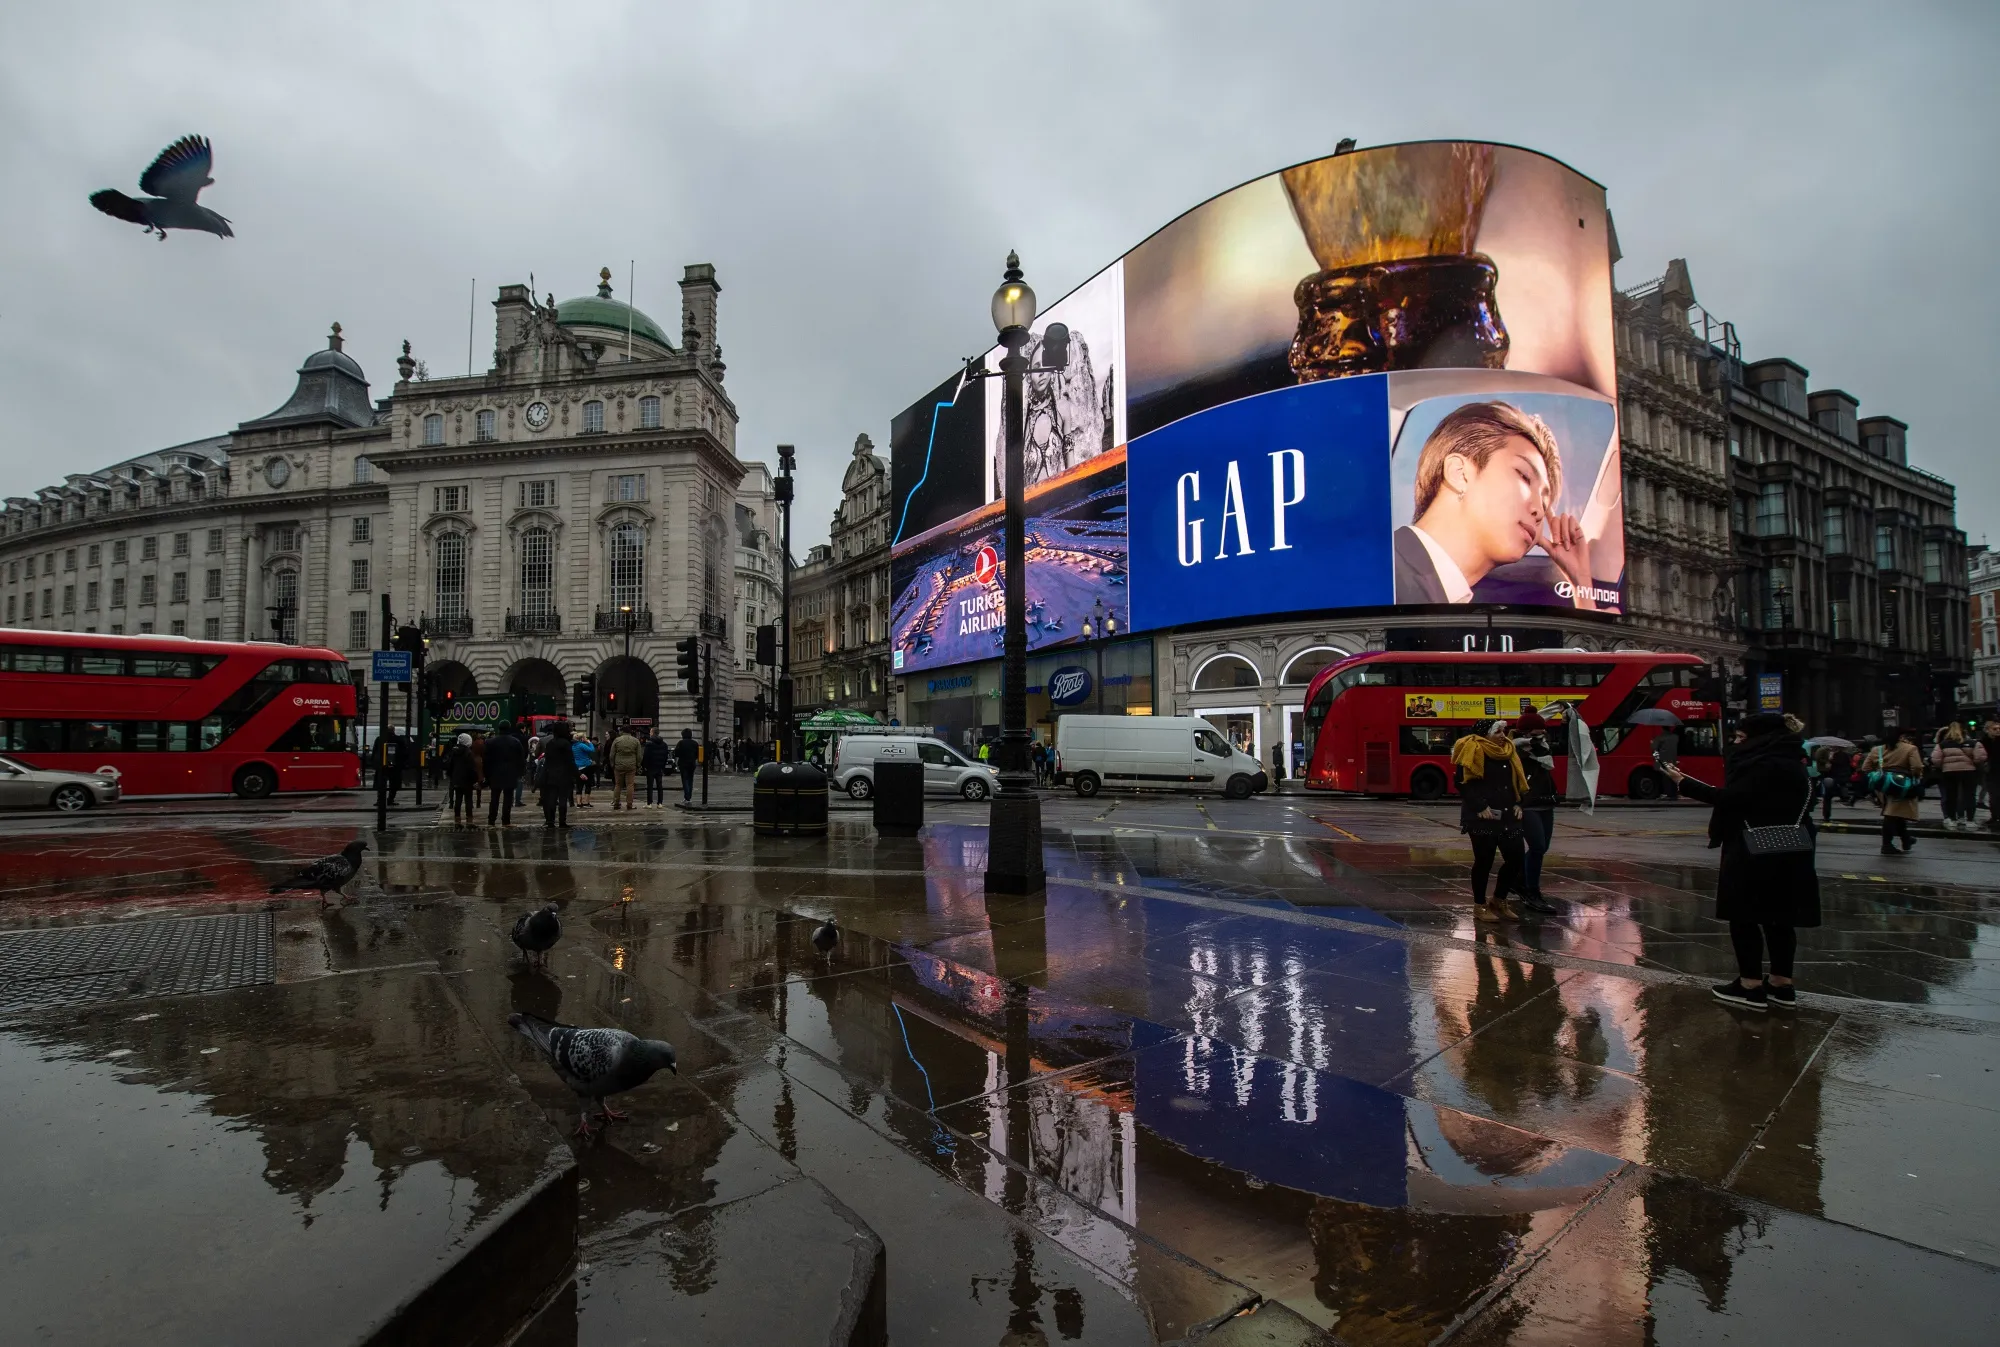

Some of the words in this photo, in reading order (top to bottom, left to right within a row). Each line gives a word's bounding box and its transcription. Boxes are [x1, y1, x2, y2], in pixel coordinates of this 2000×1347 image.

[1177, 449, 1306, 567] GAP
[974, 519, 995, 532] ALLIANCE
[960, 590, 1006, 616] TURKIS
[1577, 585, 1619, 604] HYUNDAI
[960, 610, 1006, 636] AIRLINE
[935, 676, 972, 690] BARCLAYS
[1051, 672, 1085, 699] Boots
